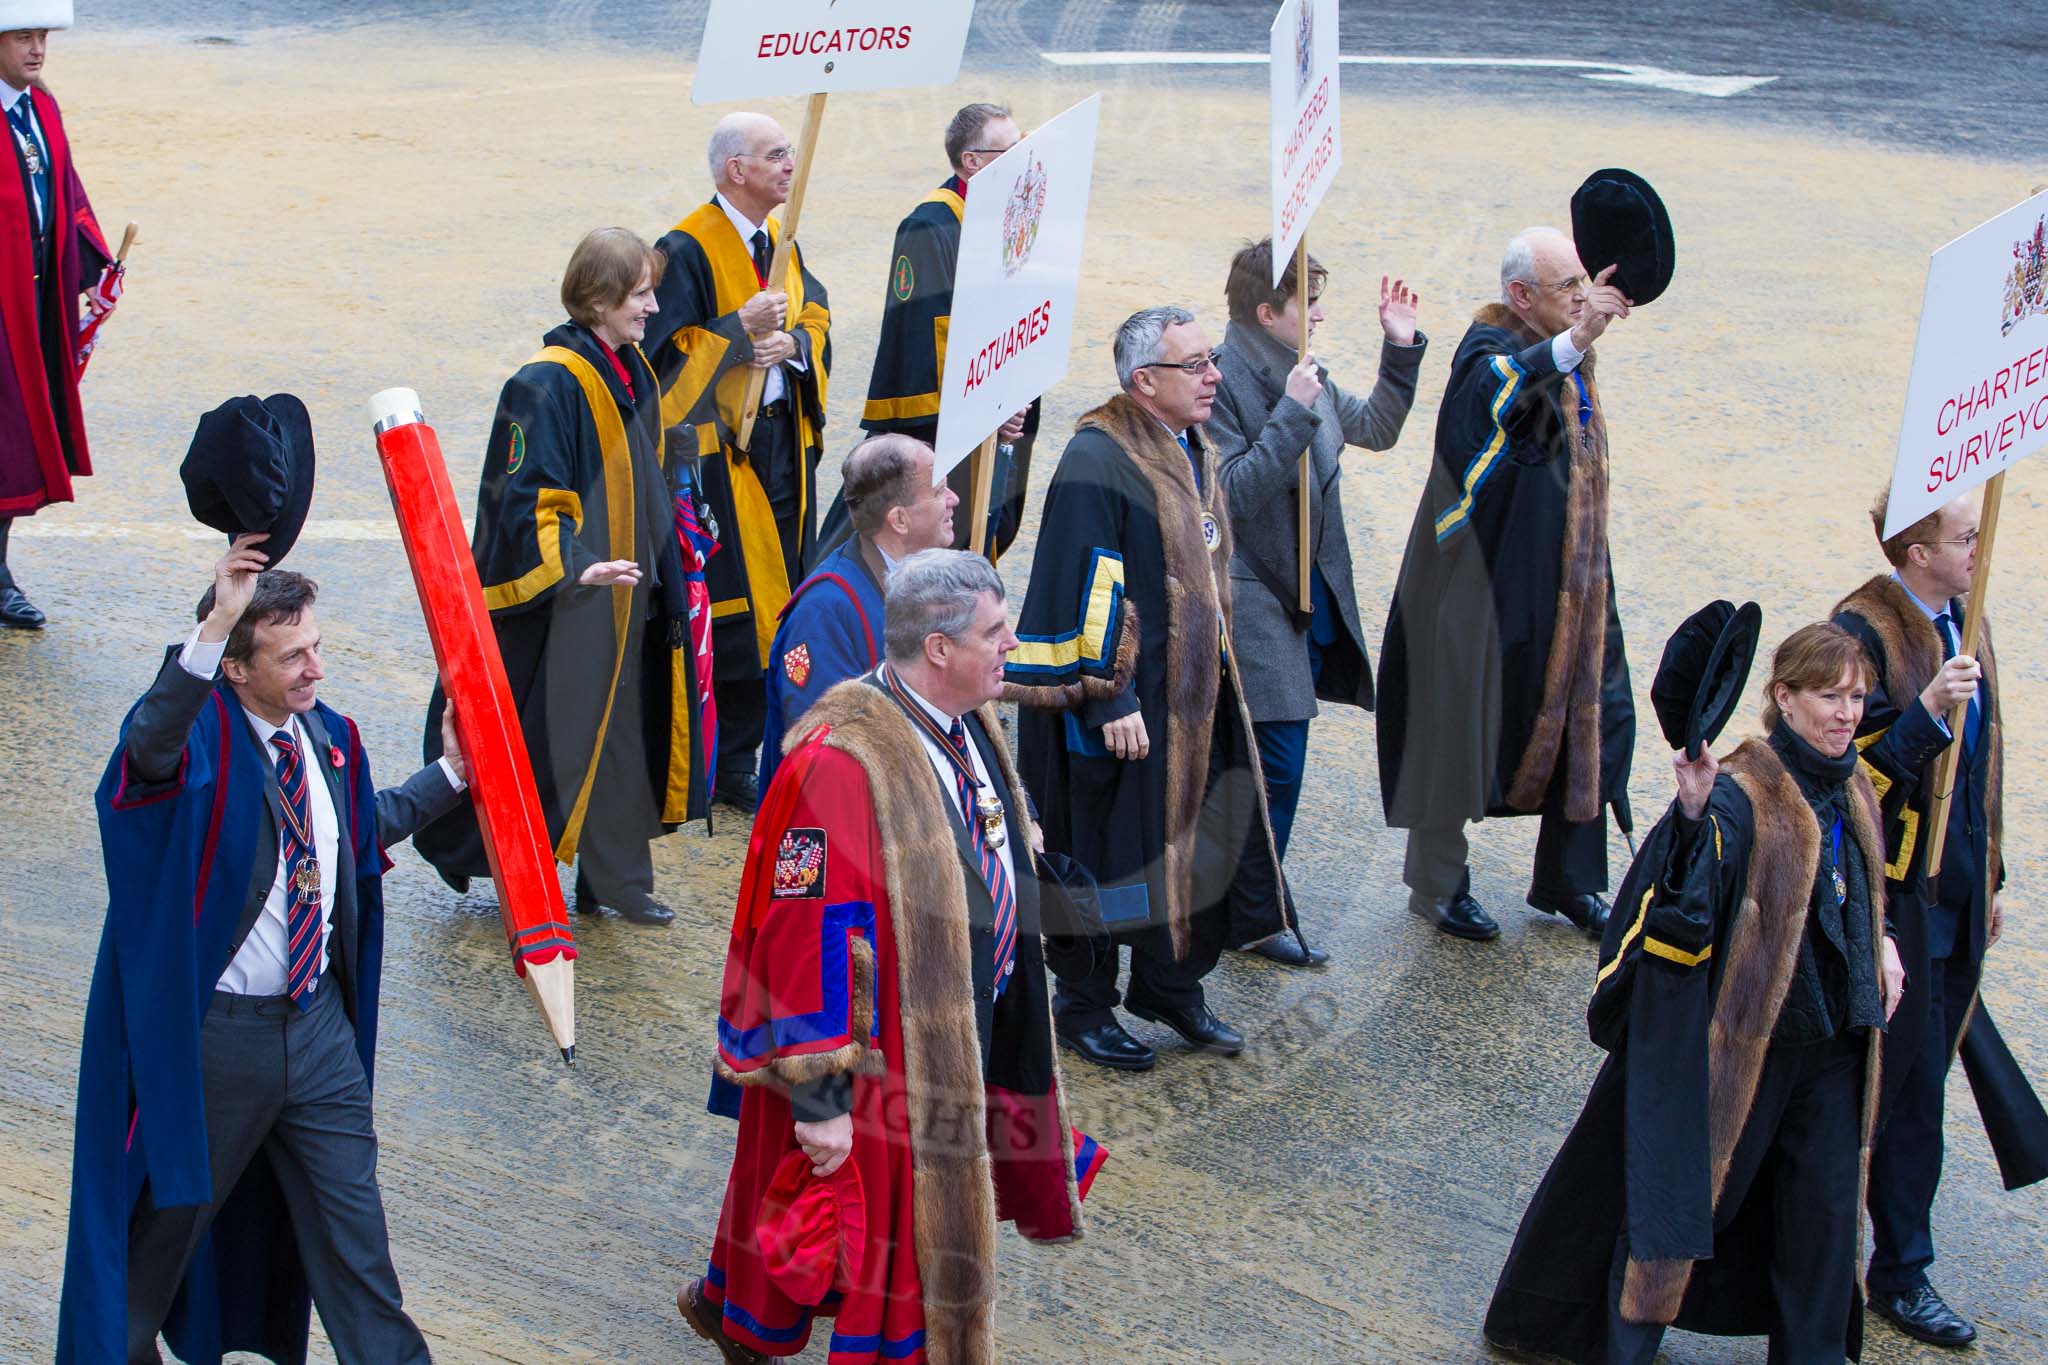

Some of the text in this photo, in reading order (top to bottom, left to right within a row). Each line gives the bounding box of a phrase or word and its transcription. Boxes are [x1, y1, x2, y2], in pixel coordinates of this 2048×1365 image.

[757, 25, 912, 58] EDUCATORS
[1282, 75, 1330, 179] CHARTERED
[1280, 124, 1334, 243] SECRETARIES
[964, 299, 1051, 398] ACTUARIES
